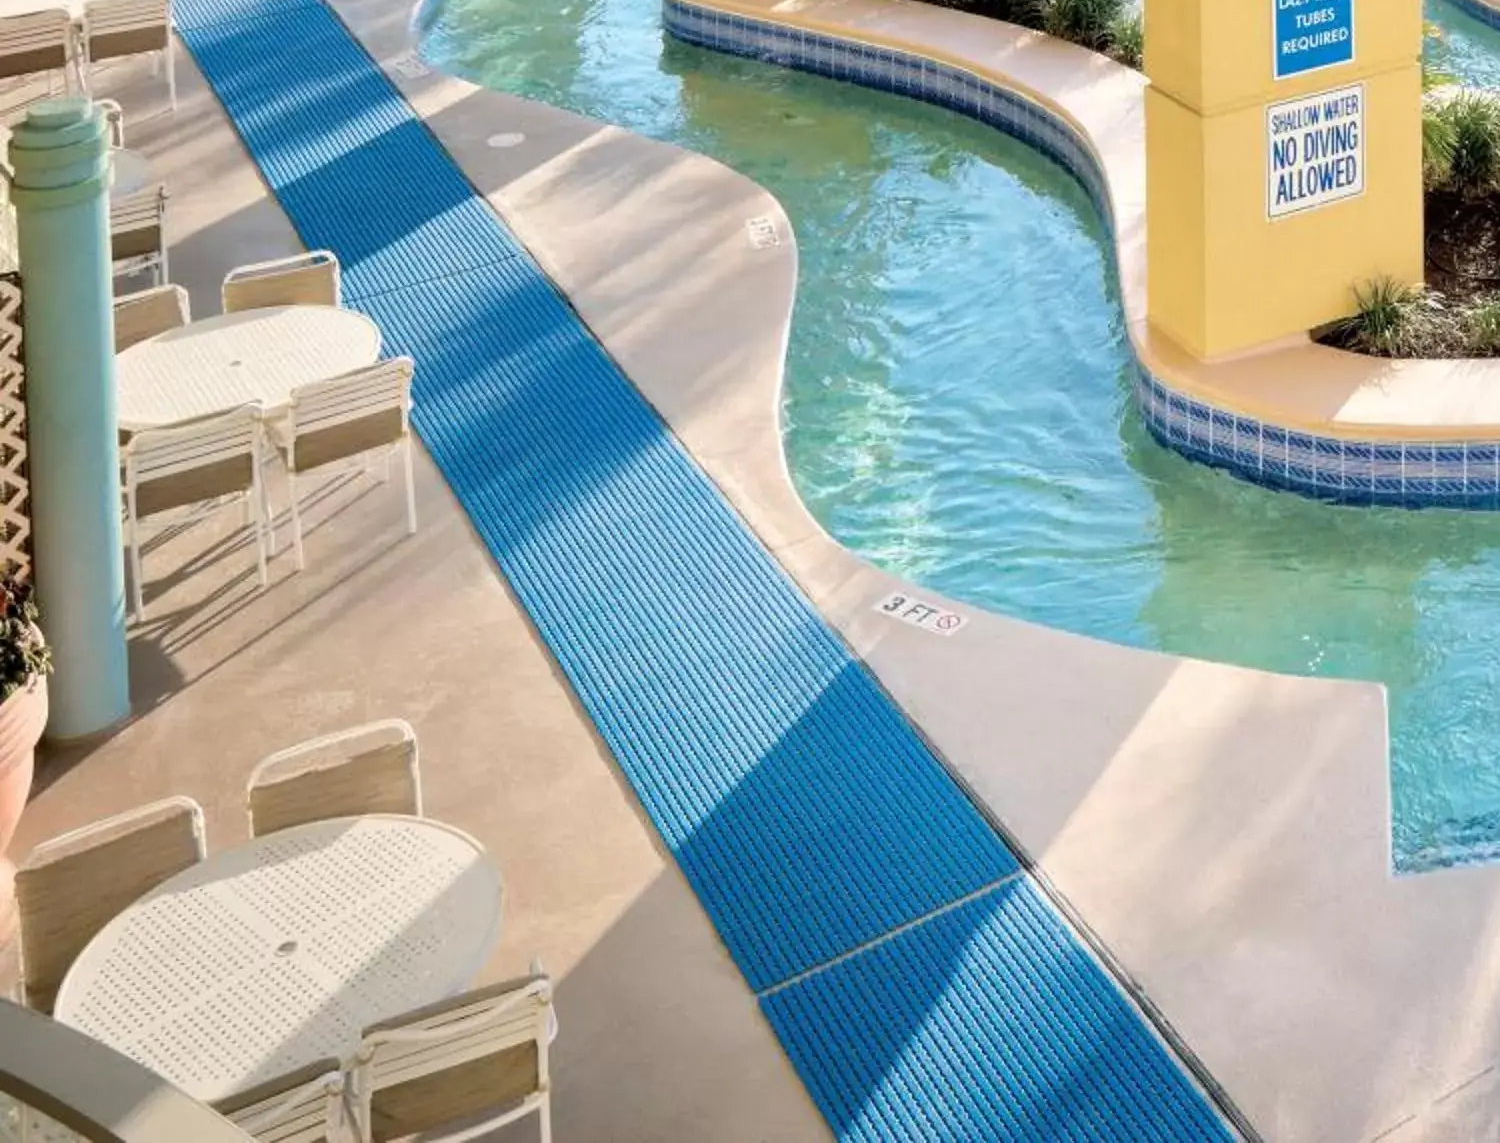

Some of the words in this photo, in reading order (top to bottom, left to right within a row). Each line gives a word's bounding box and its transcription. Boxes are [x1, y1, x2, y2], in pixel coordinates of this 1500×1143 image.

[1296, 7, 1336, 28] TUBES
[1282, 27, 1349, 55] REQUIRED
[1271, 104, 1320, 135] SHALLOW
[1323, 95, 1359, 121] WATER
[1273, 137, 1297, 171] NO
[1303, 121, 1357, 162] DIVING
[1276, 155, 1357, 205] ALLOWED
[883, 597, 906, 611] 3
[903, 604, 939, 622] FT
